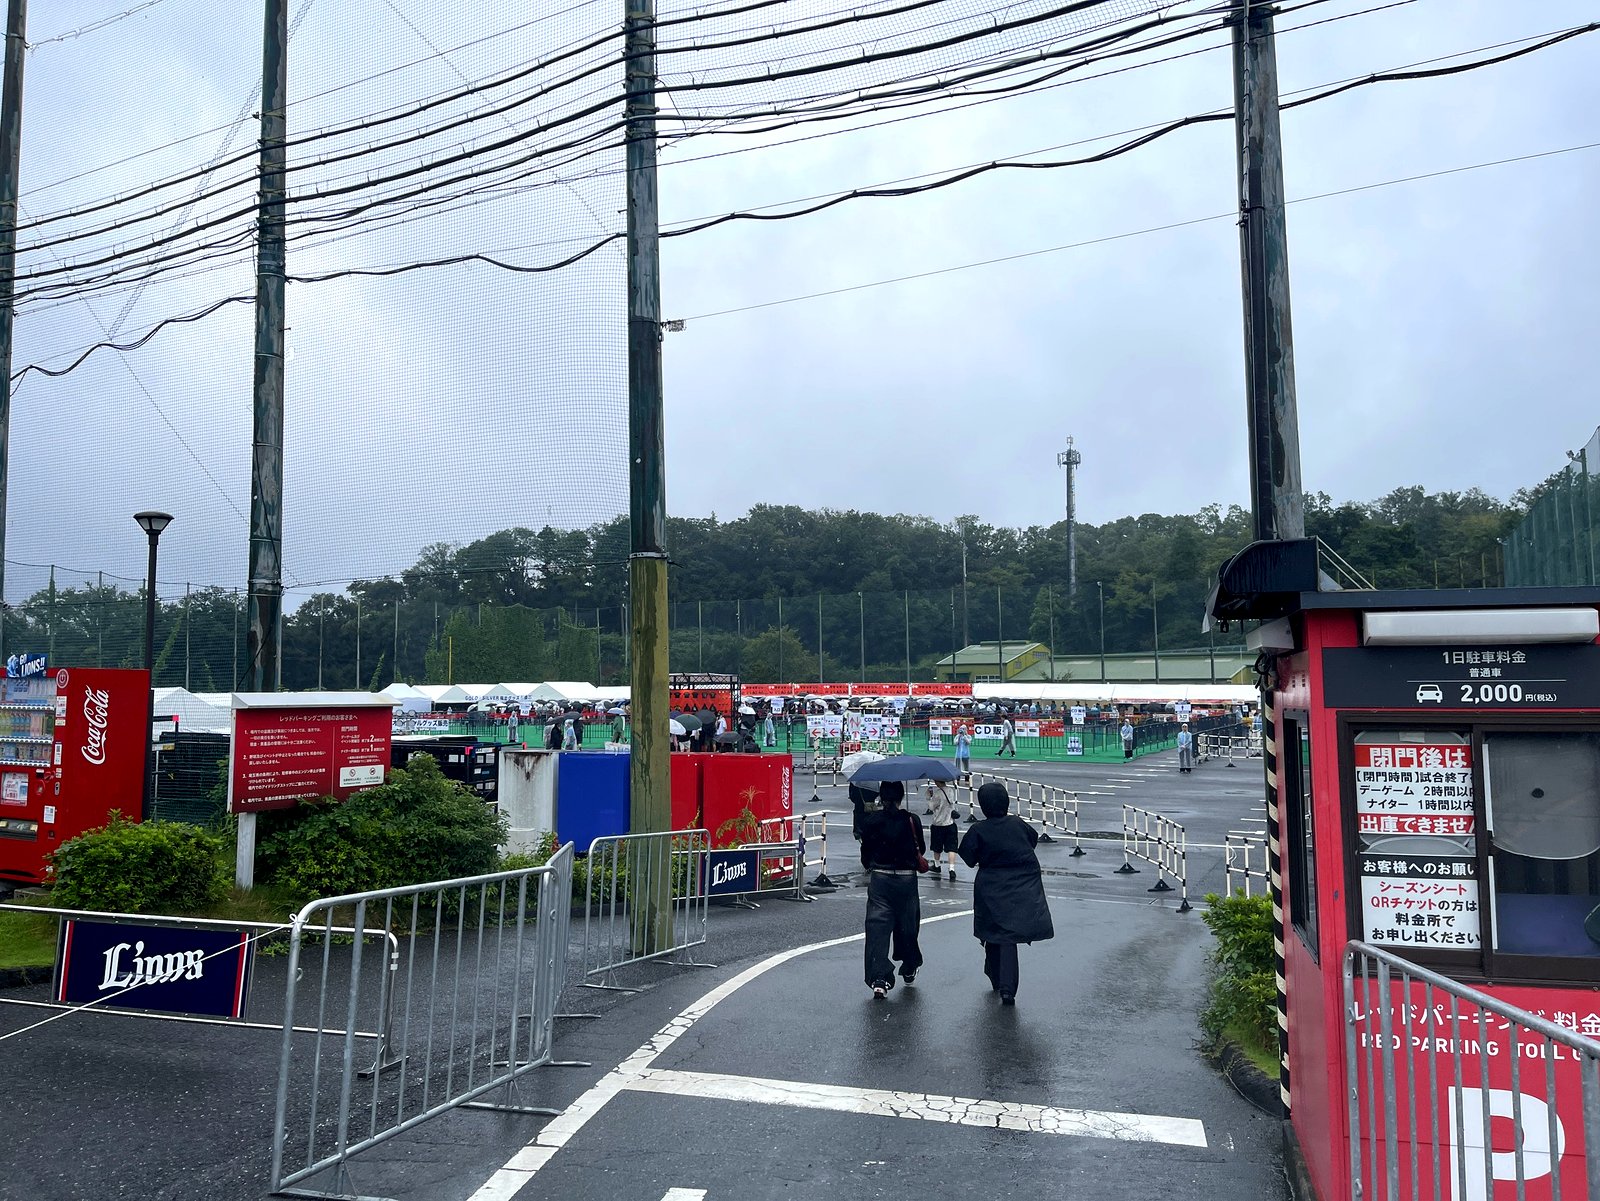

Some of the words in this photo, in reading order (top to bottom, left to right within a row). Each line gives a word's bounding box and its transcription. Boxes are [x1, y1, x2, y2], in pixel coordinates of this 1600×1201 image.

[1442, 650, 1527, 664] 1日駐車料金
[1469, 667, 1502, 678] 普通車
[1460, 684, 1522, 704] 2,000
[81, 684, 109, 765] Coca-Cola
[1369, 747, 1468, 768] 閉門後は
[1356, 771, 1472, 783] 【閉門時間】試合終了
[1359, 785, 1415, 796] デーゲーム
[1366, 798, 1409, 810] ナイター
[1418, 799, 1474, 811] 1時間以内
[711, 860, 747, 887] Lions
[1379, 881, 1467, 896] シーズンシート
[1370, 896, 1478, 912] QRチケットの方は
[1395, 912, 1456, 928] 料金所で
[1371, 928, 1480, 944] お申し出ください
[97, 940, 205, 991] Lions
